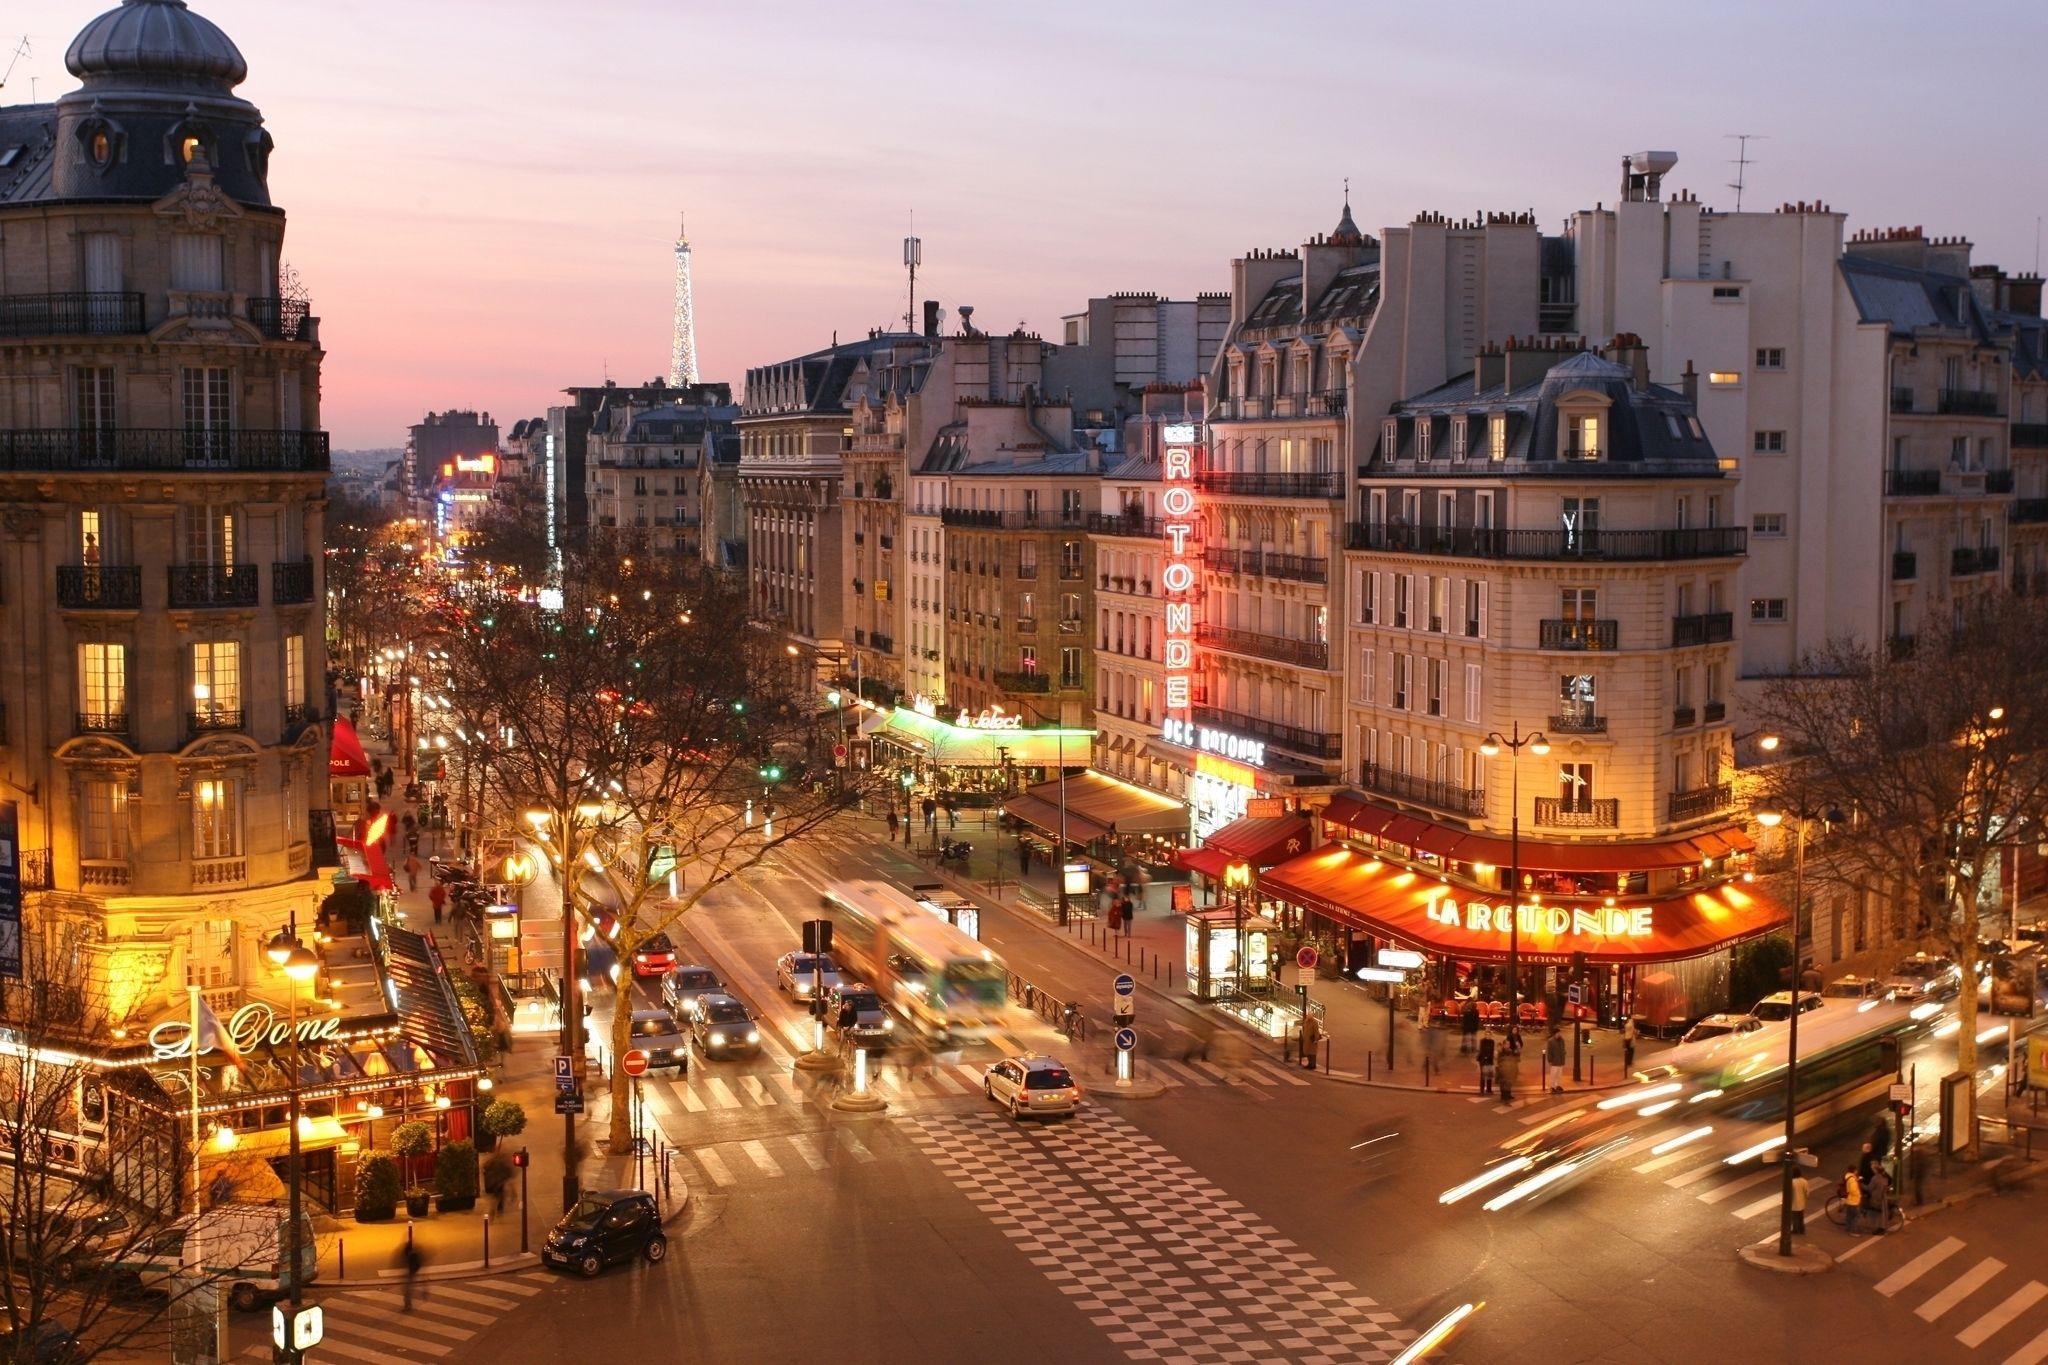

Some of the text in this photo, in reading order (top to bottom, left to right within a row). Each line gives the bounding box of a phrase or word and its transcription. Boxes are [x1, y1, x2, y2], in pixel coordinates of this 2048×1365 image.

[1163, 447, 1194, 709] ROTONDE
[1200, 728, 1265, 766] ROTONDE
[506, 857, 531, 880] M
[1226, 864, 1249, 887] M
[1427, 894, 1653, 936] LA ROTONDE
[149, 1021, 214, 1060] L
[559, 1060, 567, 1074] P
